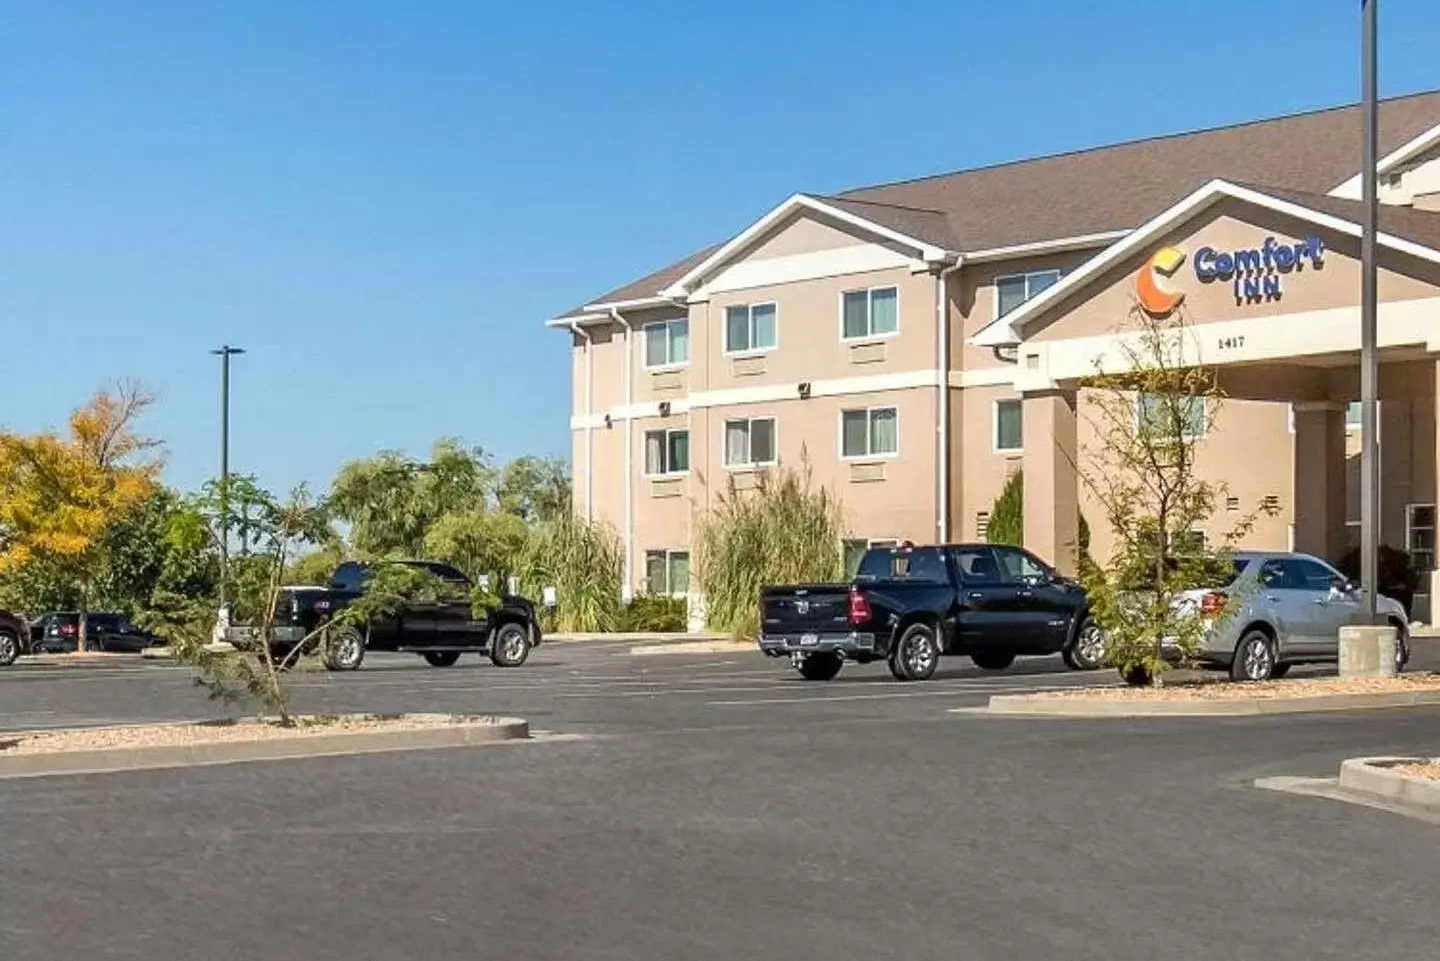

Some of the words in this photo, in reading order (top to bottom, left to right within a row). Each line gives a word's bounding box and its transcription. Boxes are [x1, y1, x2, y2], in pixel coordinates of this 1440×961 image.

[1194, 235, 1324, 281] Comfort
[1234, 274, 1281, 304] INN
[1218, 335, 1245, 350] 1417
